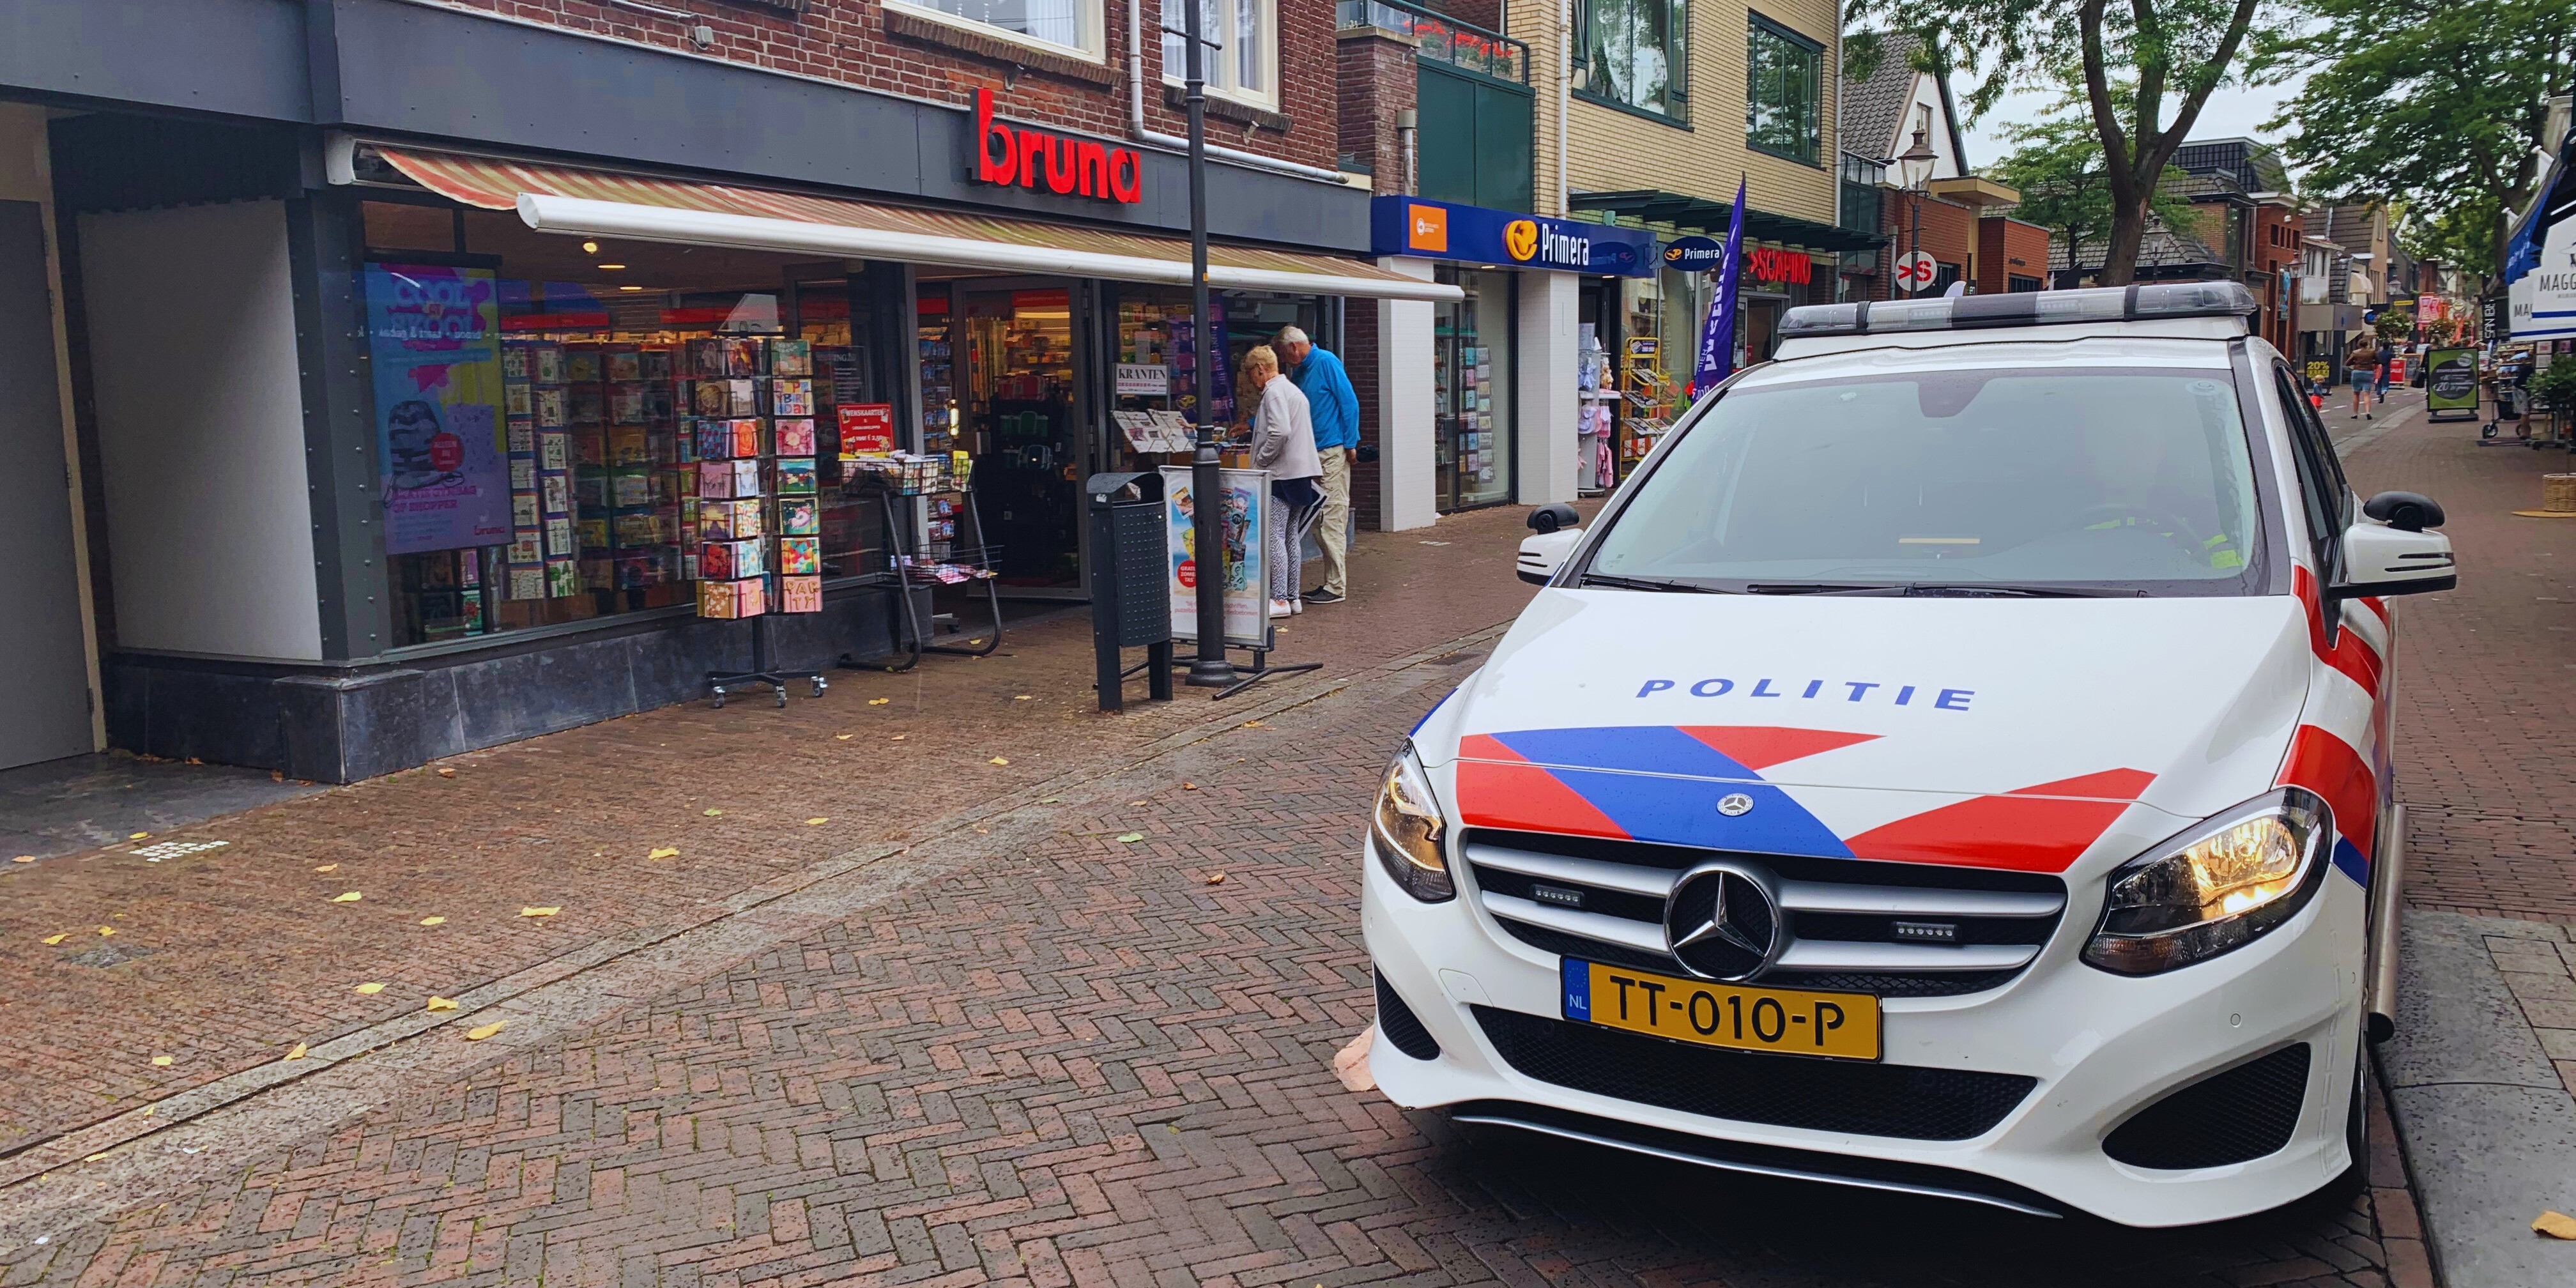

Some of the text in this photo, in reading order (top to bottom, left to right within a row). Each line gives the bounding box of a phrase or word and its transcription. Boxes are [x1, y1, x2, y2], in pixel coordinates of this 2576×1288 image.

[977, 88, 1141, 204] bruna
[1542, 223, 1589, 266] Primera
[1684, 248, 1720, 260] Primera
[1119, 368, 1166, 379] KRANTEN
[2307, 361, 2330, 370] 20%
[1636, 678, 1976, 711] POLITIE
[1569, 975, 1844, 1046] NL TT-010-P
